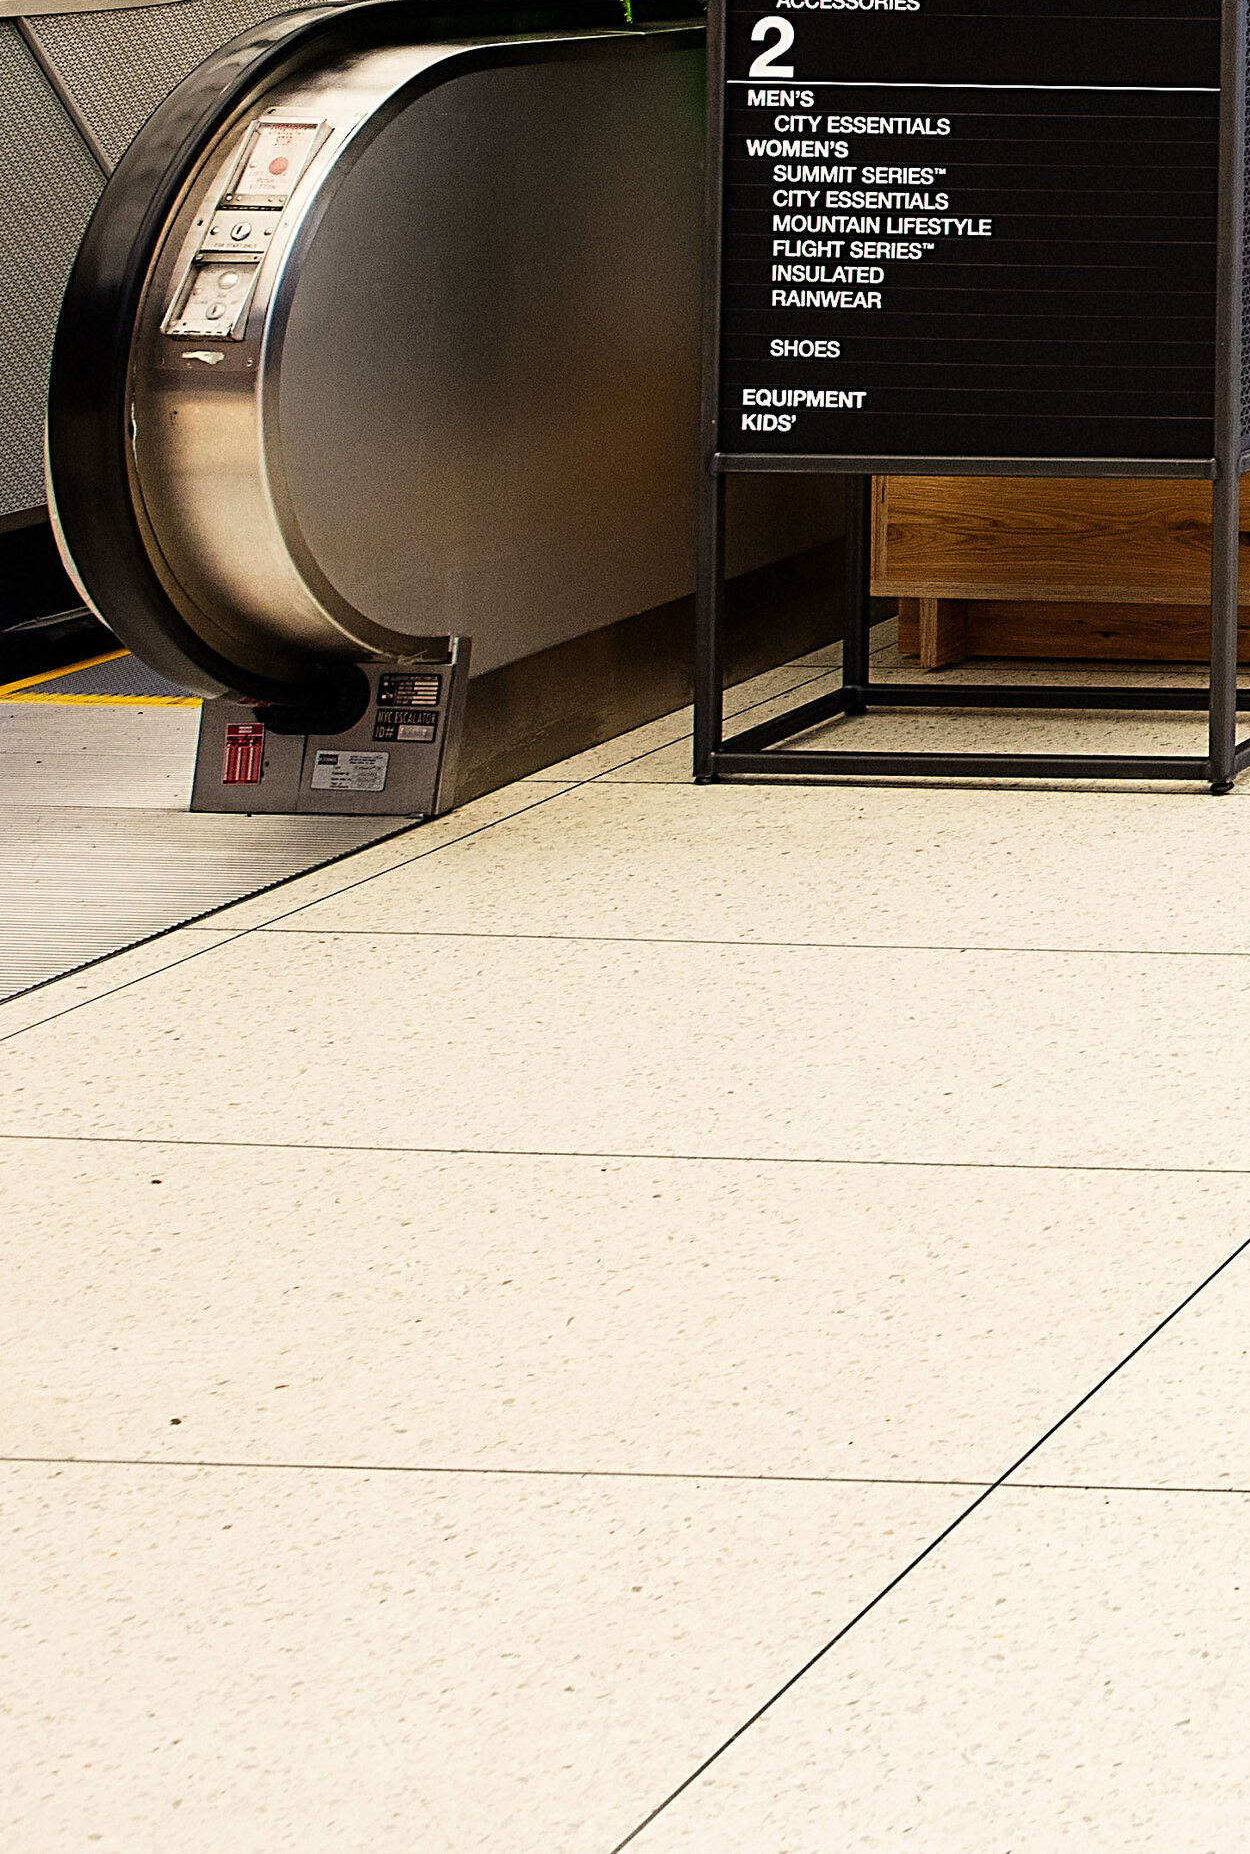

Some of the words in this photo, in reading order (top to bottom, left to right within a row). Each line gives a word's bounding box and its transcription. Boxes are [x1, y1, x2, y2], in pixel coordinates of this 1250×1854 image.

[749, 16, 795, 78] 2
[747, 90, 814, 107] MEN'S
[774, 115, 822, 133] CITY
[828, 116, 951, 135] ESSENTIALS
[746, 139, 849, 158] WOMEN'S
[773, 165, 857, 183] SUMMIT
[772, 190, 820, 208] CITY
[826, 191, 949, 210] ESSENTIALS
[772, 215, 880, 234] MOUNTAIN
[887, 216, 992, 235] LIFESTYLE
[772, 240, 845, 258] FLIGHT
[772, 265, 884, 283] INSULATED
[771, 290, 882, 308] RAINWEAR
[770, 339, 840, 357] SHOES
[742, 389, 867, 408] EQUIPMENT
[741, 414, 797, 431] KIDS'
[377, 711, 393, 723] NYC
[394, 711, 436, 724] ESCALATOR
[375, 726, 394, 738] ID#
